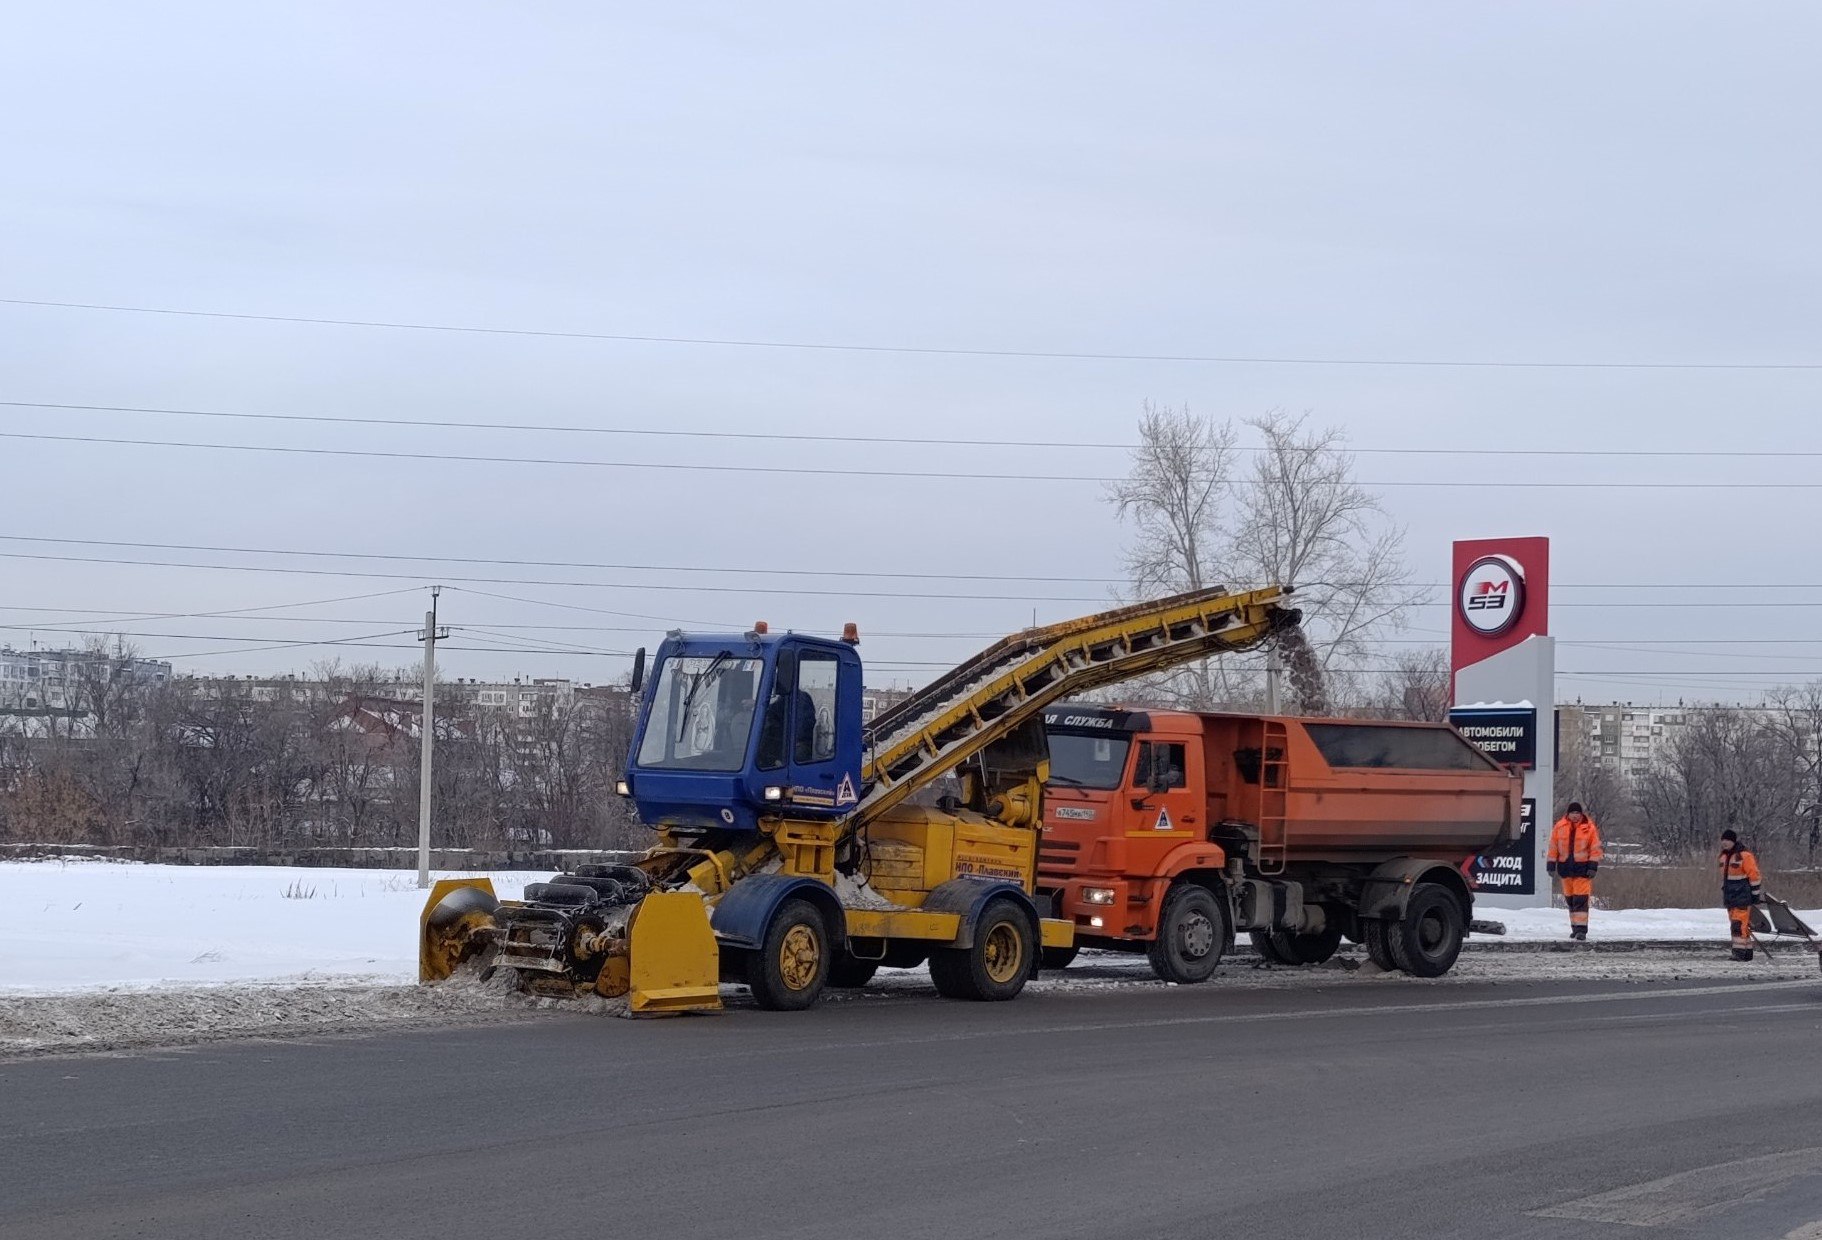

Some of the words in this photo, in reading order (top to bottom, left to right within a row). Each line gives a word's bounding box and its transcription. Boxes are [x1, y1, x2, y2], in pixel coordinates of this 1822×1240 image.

[1064, 715, 1114, 729] СЛУЖБА
[1458, 726, 1524, 738] АВТОМОБИЛИ
[955, 862, 973, 873] НПО
[1492, 856, 1523, 871] УХОД
[1475, 872, 1523, 887] ЗАЩИТА
